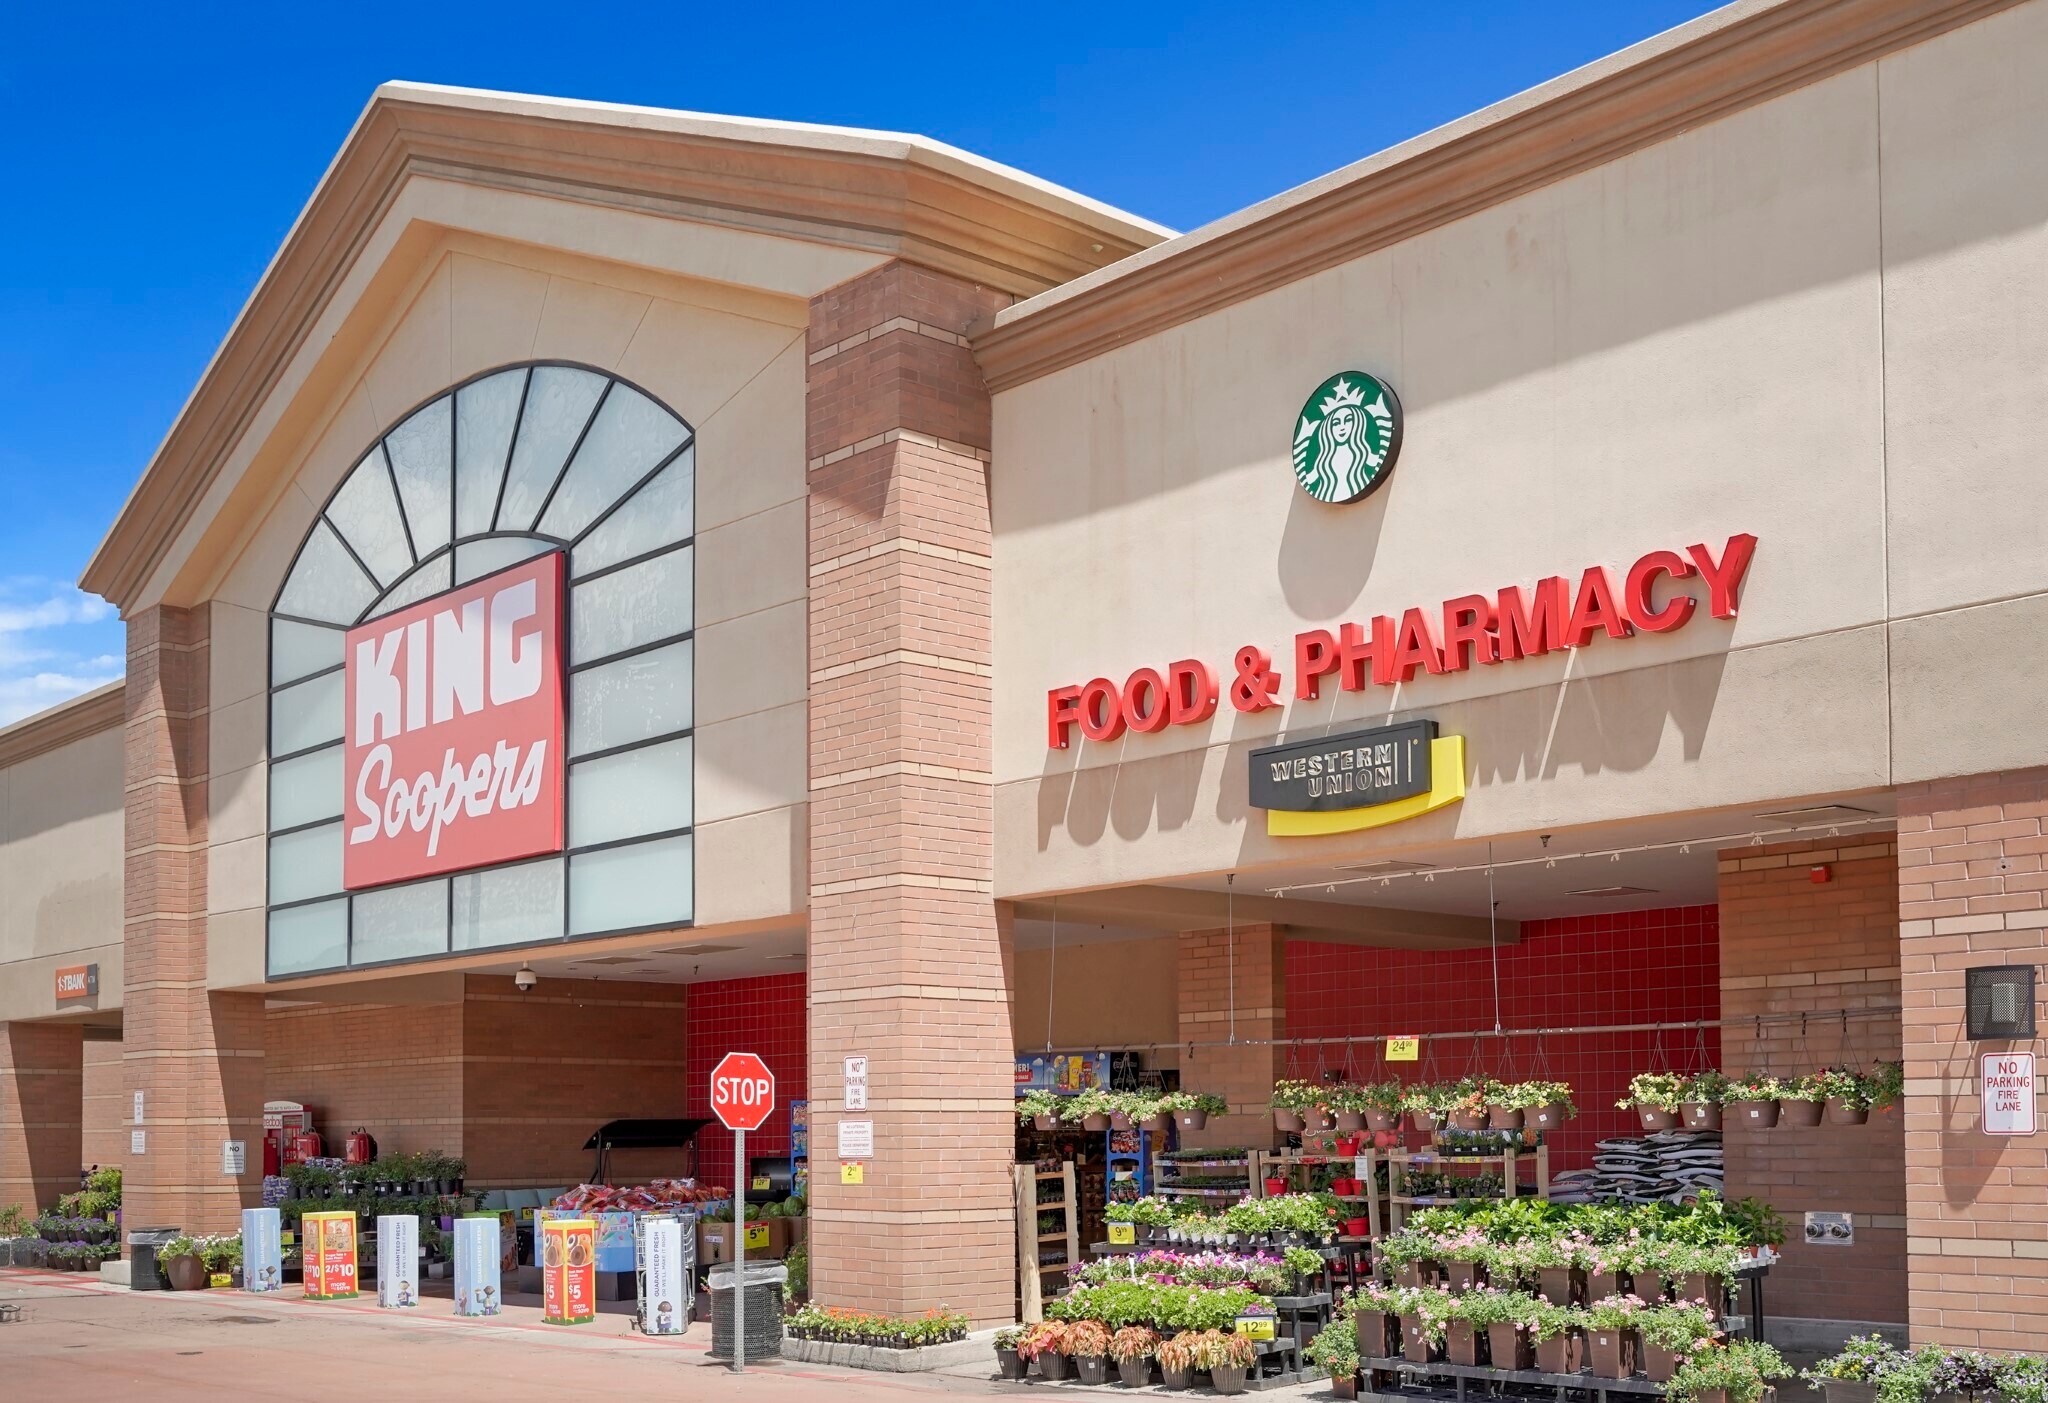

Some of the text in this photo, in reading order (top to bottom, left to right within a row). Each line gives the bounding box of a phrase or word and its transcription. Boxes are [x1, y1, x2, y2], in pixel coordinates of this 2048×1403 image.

[1048, 533, 1758, 750] FOOD & PHARMACY
[355, 578, 542, 748] KING
[1270, 742, 1392, 782] WESTERN
[1307, 765, 1392, 798] UNION
[350, 739, 547, 857] Soopers
[851, 1062, 861, 1072] NO
[1998, 1061, 2018, 1074] NO
[846, 1076, 865, 1086] PARKING
[1987, 1076, 2030, 1088] PARKING
[715, 1076, 770, 1106] STOP
[850, 1088, 861, 1096] FIRE
[1998, 1090, 2018, 1099] FIRE
[1995, 1102, 2021, 1111] LANE
[568, 1284, 582, 1300] $5
[662, 1288, 667, 1297] OR
